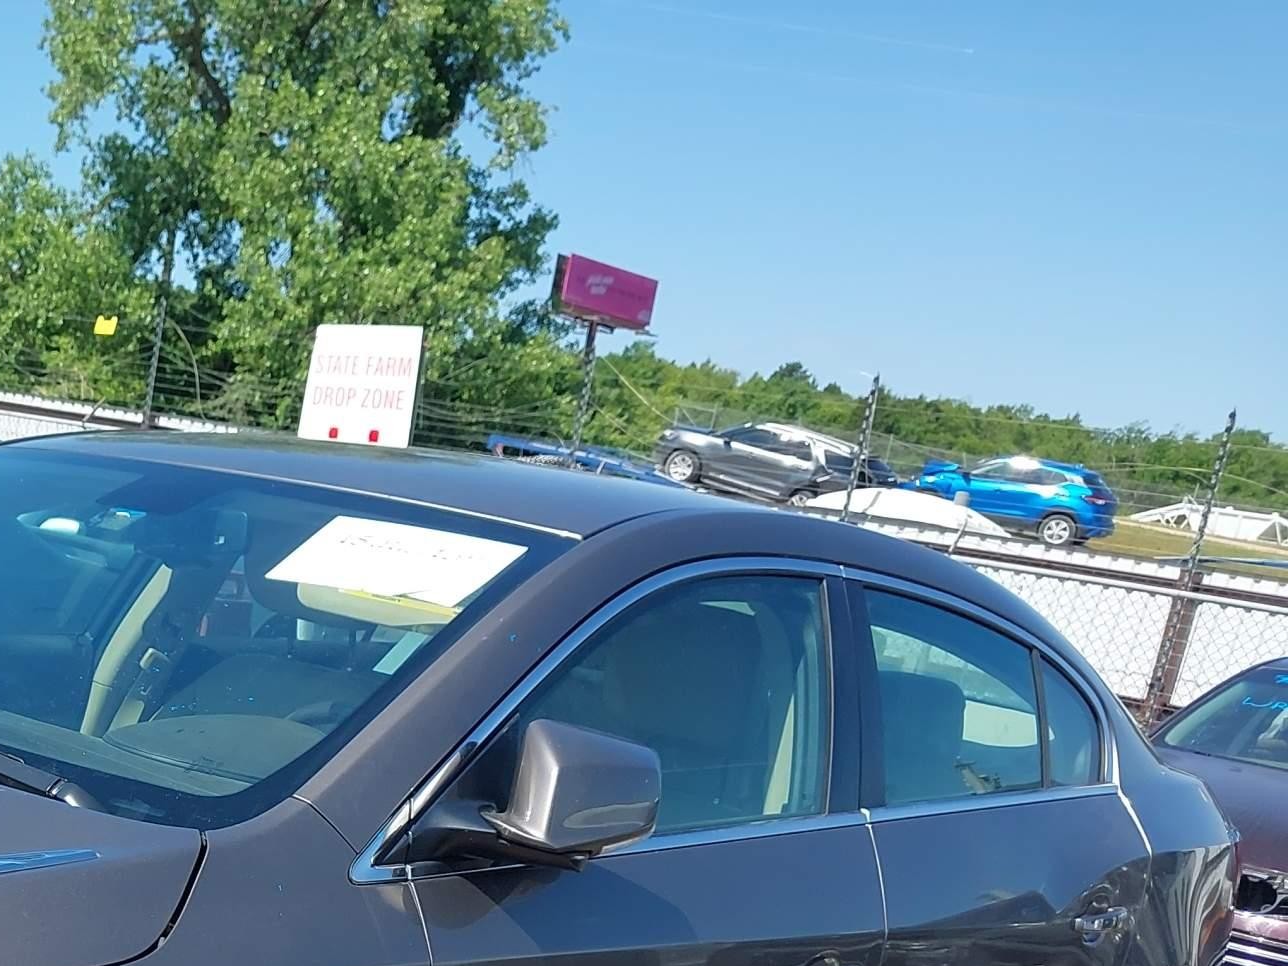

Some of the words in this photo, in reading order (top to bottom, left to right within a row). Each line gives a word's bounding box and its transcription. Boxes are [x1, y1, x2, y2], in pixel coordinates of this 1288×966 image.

[314, 356, 359, 376] STATE
[366, 358, 413, 378] FARM
[313, 386, 357, 407] DROP
[361, 389, 405, 410] ZONE
